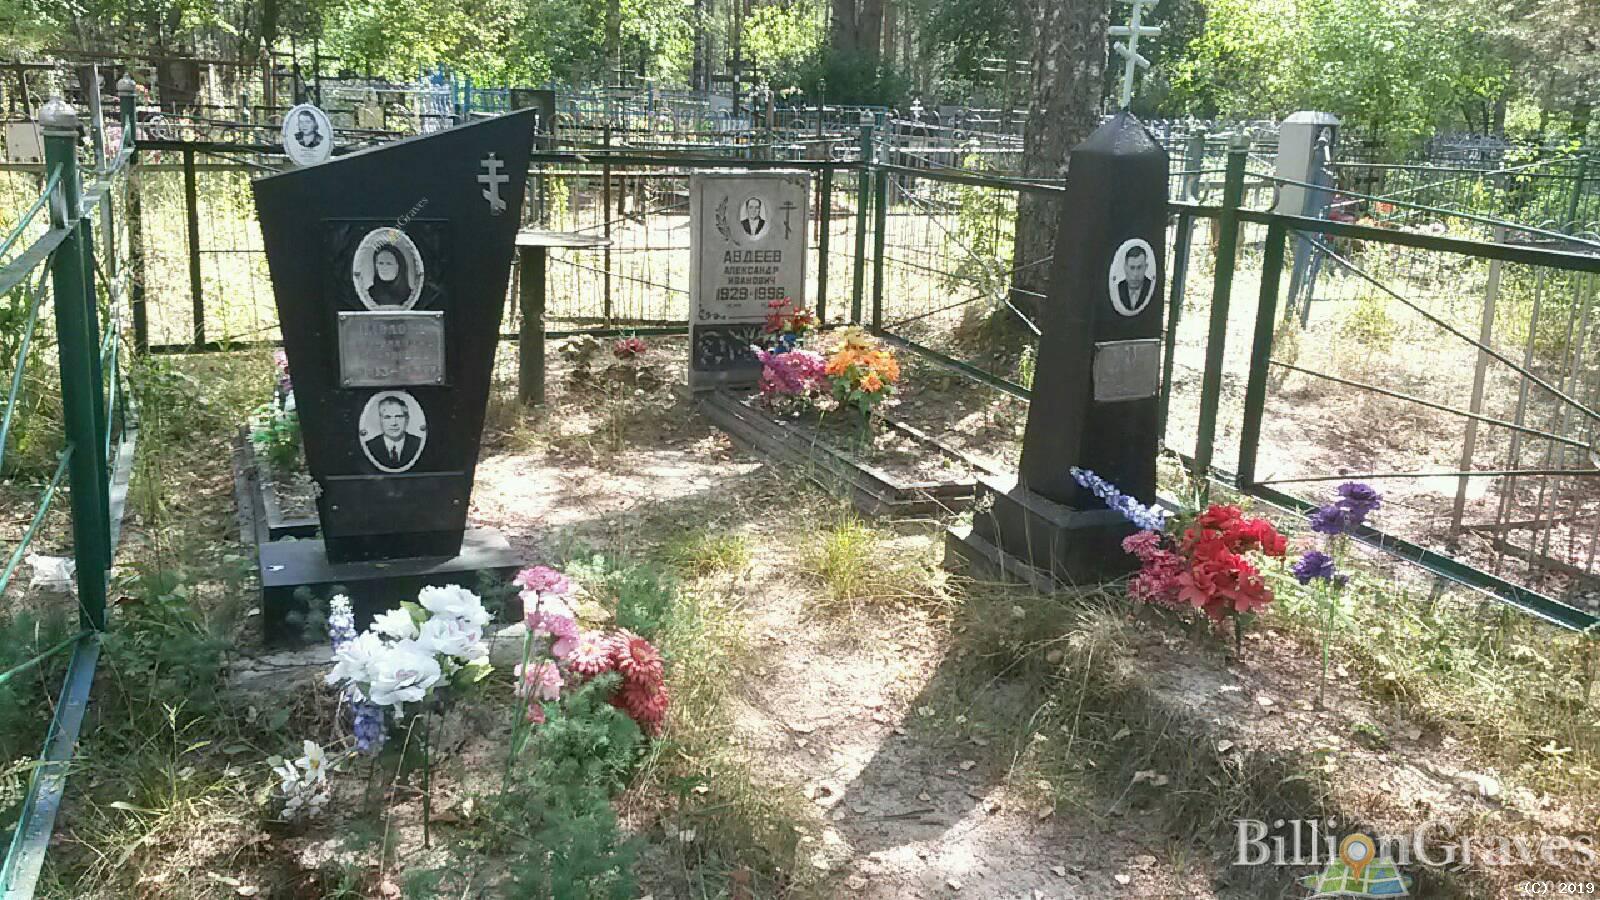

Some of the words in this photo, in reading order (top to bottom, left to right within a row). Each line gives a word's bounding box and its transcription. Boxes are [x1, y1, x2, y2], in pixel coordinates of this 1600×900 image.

[724, 250, 782, 263] АВДЕЕВ
[724, 266, 779, 275] АЛЕКСАНДР
[728, 276, 776, 285] ИВАНОВИЧ
